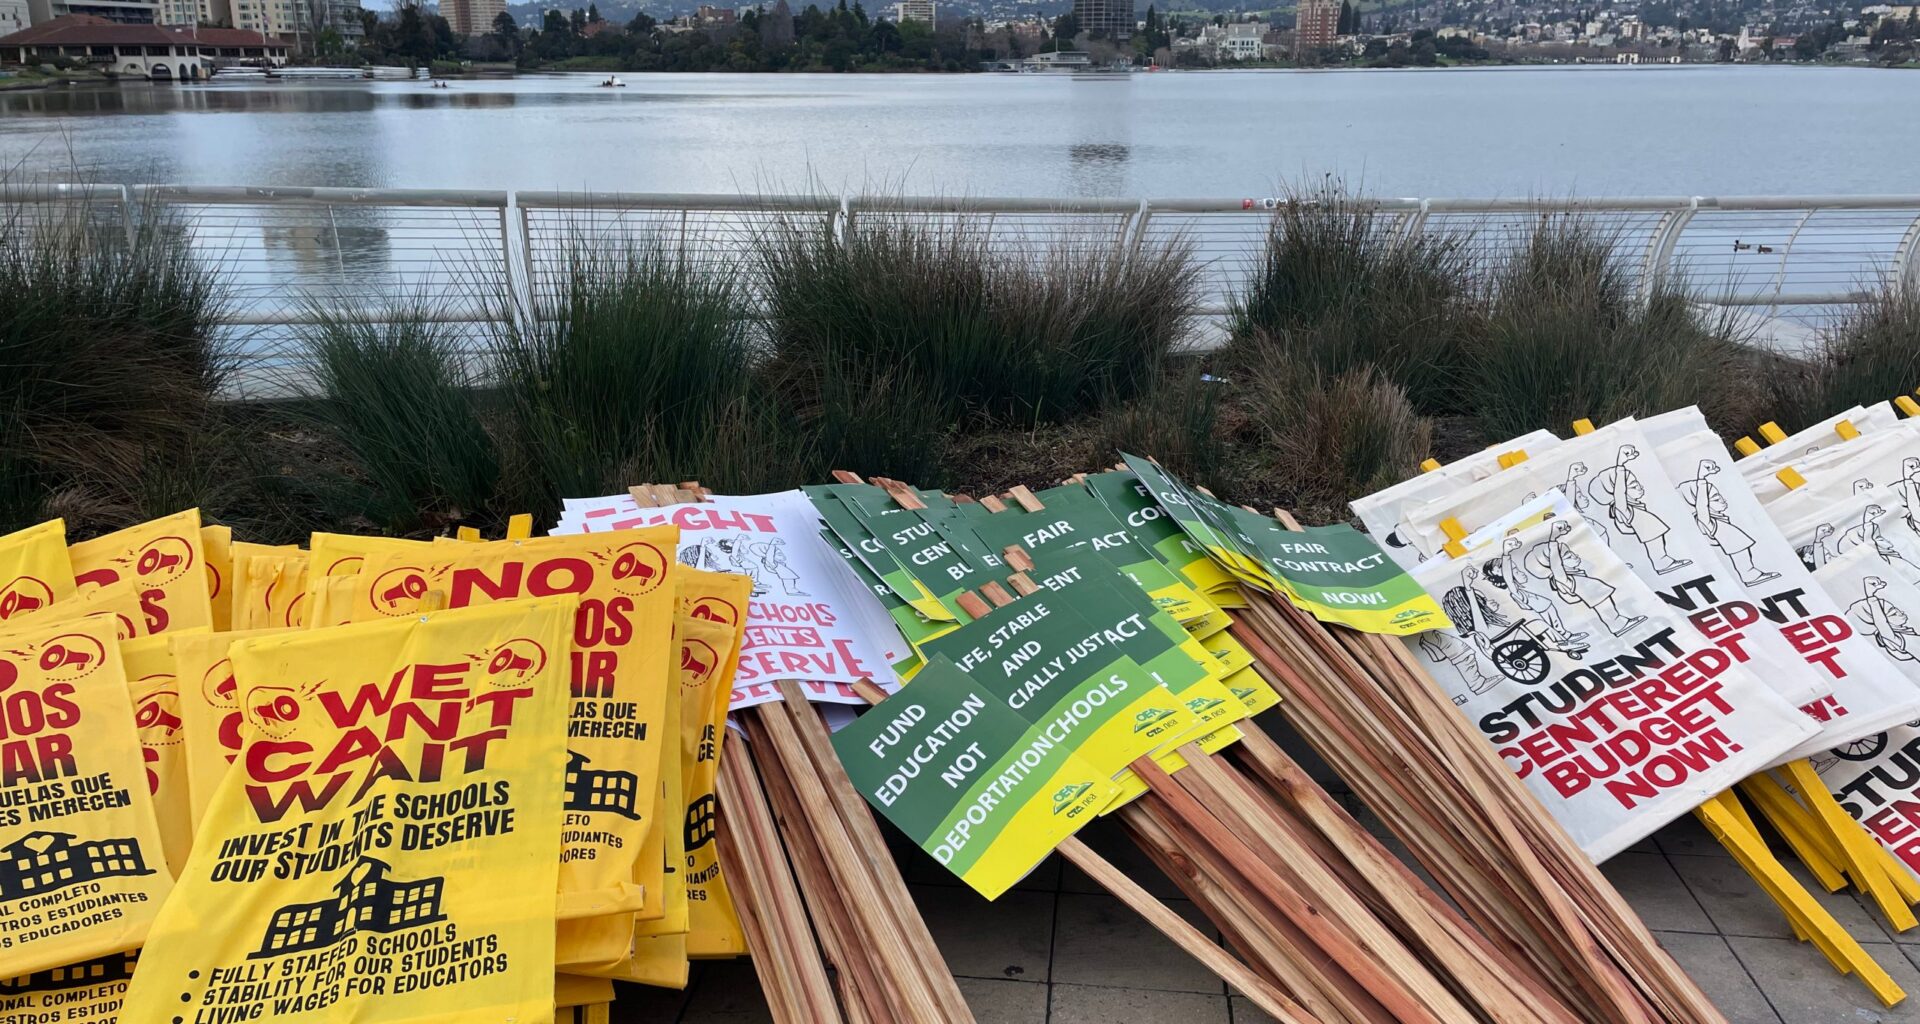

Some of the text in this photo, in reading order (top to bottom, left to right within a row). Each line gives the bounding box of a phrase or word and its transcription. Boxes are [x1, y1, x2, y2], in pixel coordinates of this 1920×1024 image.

[1023, 521, 1075, 549] FAIR
[1280, 543, 1330, 555] FAIR
[449, 557, 595, 609] NO
[1272, 552, 1385, 574] CONTRACT
[747, 602, 837, 627] CHOOLS
[1321, 591, 1388, 605] NOW!
[988, 603, 1050, 649] STABLE
[735, 639, 874, 680] SERVE
[1002, 640, 1042, 678] AND
[1008, 632, 1105, 709] CIALLY JUST
[1479, 626, 1686, 744] STUDENT
[317, 663, 470, 728] WE
[602, 702, 638, 721] QUE
[1045, 674, 1129, 743] CHOOLS
[1498, 648, 1731, 780] CENTERED
[245, 688, 534, 783] CAN'T
[868, 703, 926, 759] FUND
[874, 692, 986, 808] EDUCATION
[1543, 682, 1735, 799] BUDGET
[0, 782, 65, 808] UELAS
[71, 772, 114, 796] QUE
[245, 729, 508, 823] WAIT
[940, 741, 987, 789] NOT
[1603, 727, 1744, 810] NOW!
[28, 788, 132, 823] MERECEN
[218, 780, 510, 860] INVEST IN THE SCHOOLS
[931, 734, 1054, 867] DEPORTATION
[210, 808, 515, 883] OUR STUDENTS DESERVE
[19, 882, 102, 913] COMPLETO
[47, 891, 149, 922] ESTUDIANTES
[19, 907, 123, 944] EDUCADORES
[203, 933, 498, 1006] STABILITY FOR OUR STUDENTS
[208, 922, 457, 988] FULLY STAFFED SCHOOLS
[42, 982, 128, 1008] COMPLETO
[67, 998, 123, 1020] ESTUDI
[194, 953, 508, 1024] LIVING WAGES FOR EDUCATORS
